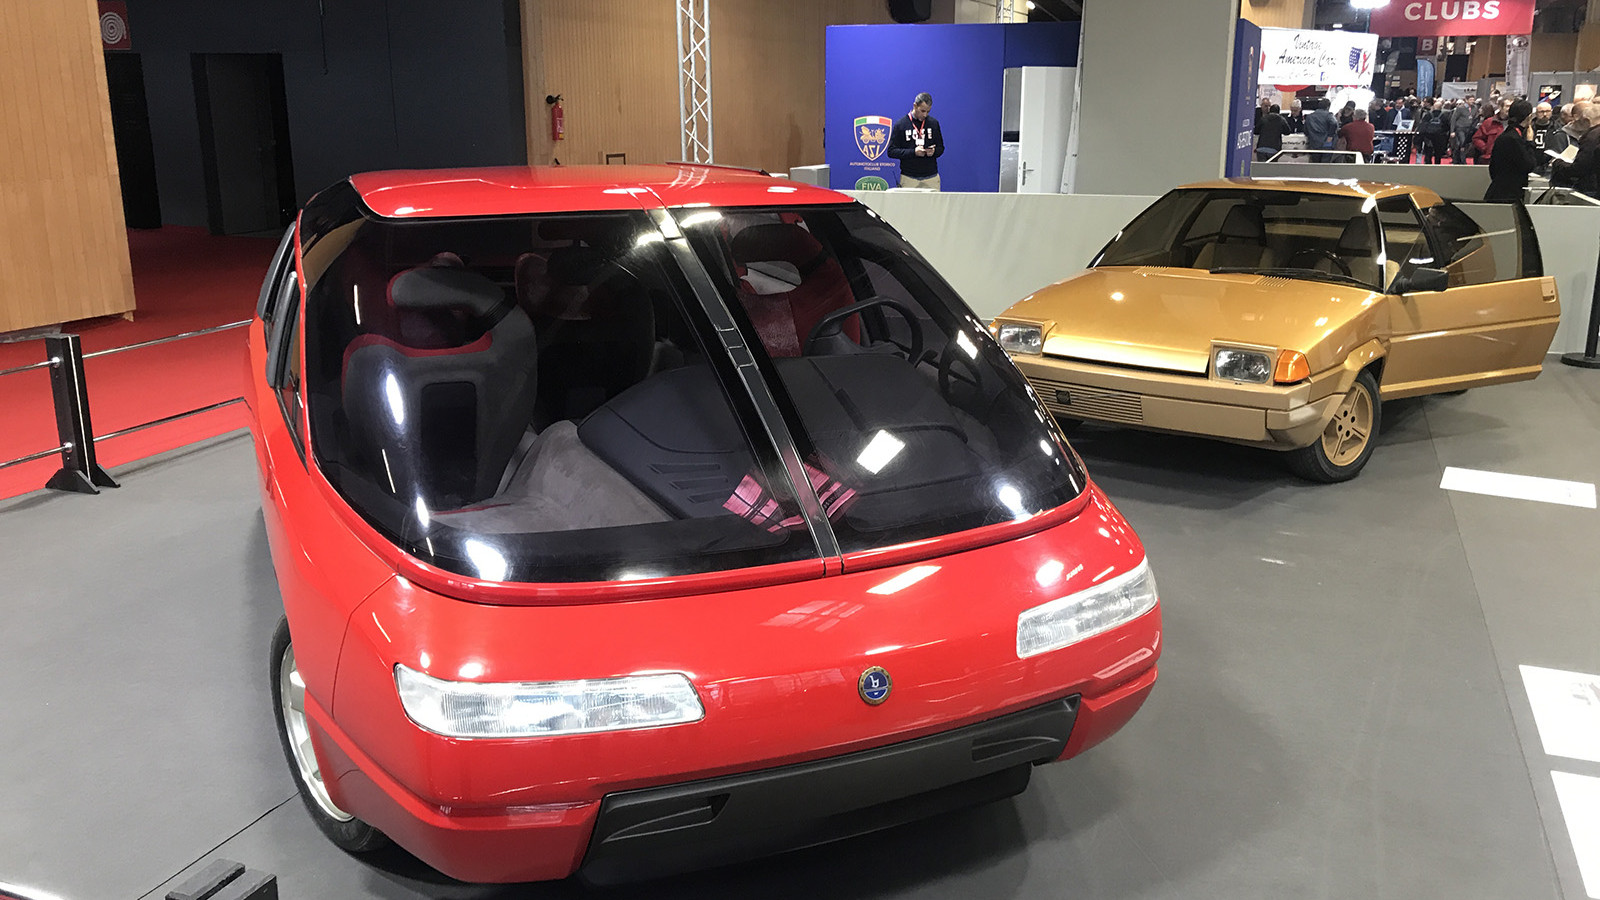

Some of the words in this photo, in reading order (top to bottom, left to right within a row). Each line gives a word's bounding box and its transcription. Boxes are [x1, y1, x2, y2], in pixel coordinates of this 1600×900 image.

[1404, 0, 1500, 20] CLUBS
[1421, 38, 1434, 51] B
[1276, 48, 1316, 65] American
[862, 182, 882, 191] FIVA
